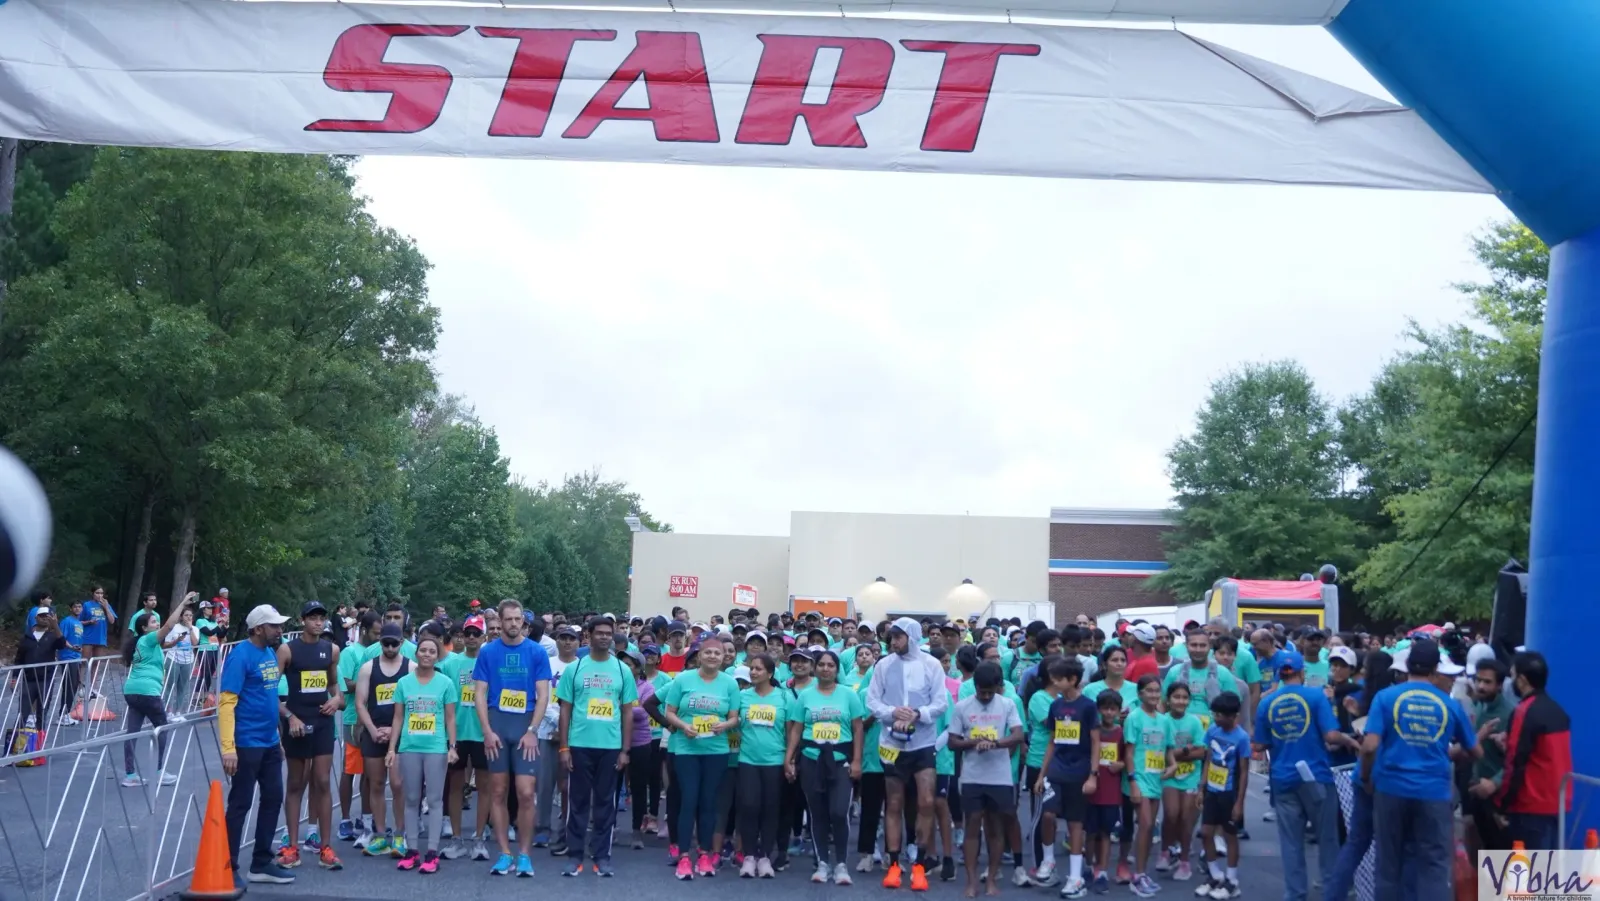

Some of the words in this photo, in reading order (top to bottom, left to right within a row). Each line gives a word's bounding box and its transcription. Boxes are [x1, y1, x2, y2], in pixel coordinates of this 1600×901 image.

[303, 23, 1041, 153] START
[671, 576, 680, 585] 5K
[681, 576, 697, 586] RUN
[684, 586, 697, 594] AM
[304, 679, 326, 688] 7209
[502, 696, 525, 708] 7026
[590, 706, 612, 716] 7274
[751, 711, 773, 721] 7008
[411, 721, 434, 730] 7067
[815, 730, 838, 739] 7079
[1057, 728, 1077, 738] 7030
